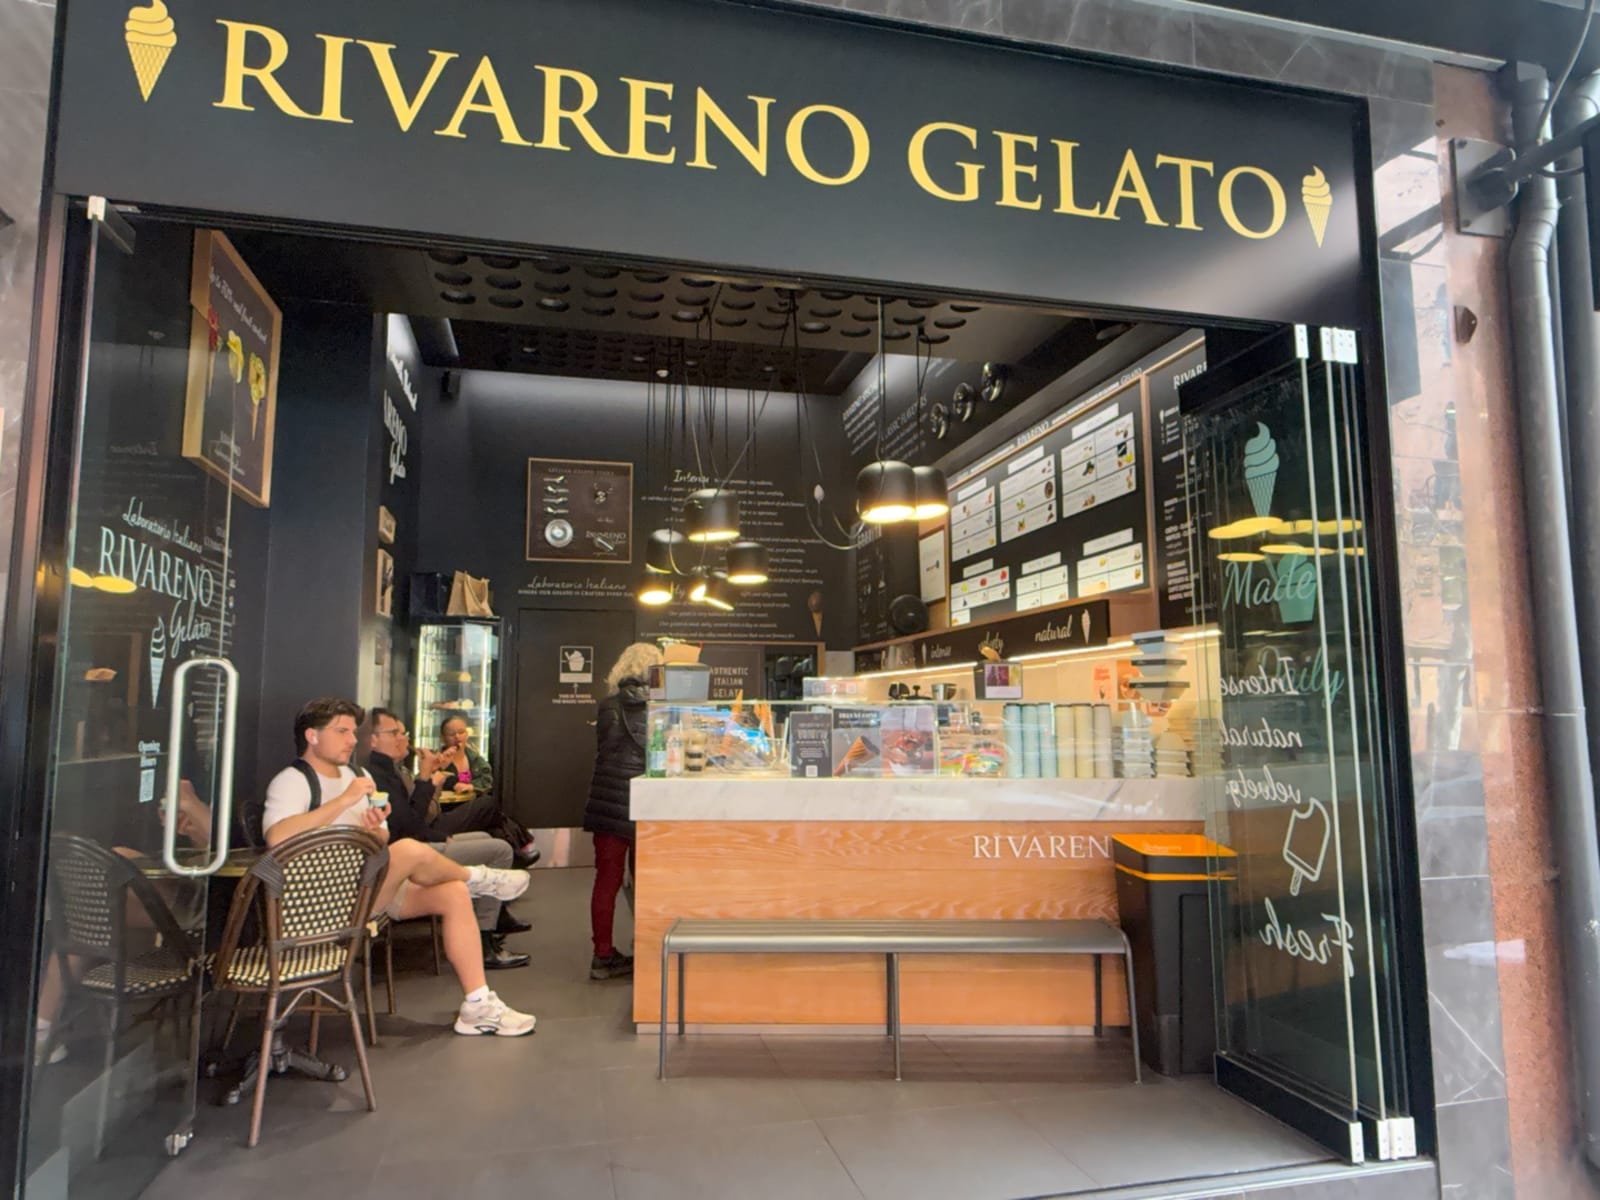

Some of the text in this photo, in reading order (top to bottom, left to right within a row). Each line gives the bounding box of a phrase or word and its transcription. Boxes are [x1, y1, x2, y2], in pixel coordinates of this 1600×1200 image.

[214, 20, 1287, 241] RIVARENO GELATO
[122, 496, 171, 539] Laboratorio
[172, 519, 202, 554] Italiano
[98, 526, 215, 608] RIVARENO
[1222, 548, 1314, 613] Made
[170, 599, 212, 659] Gelato
[1034, 613, 1073, 643] natural
[712, 688, 743, 699] GELAT
[713, 677, 744, 687] ITALIAN
[972, 834, 1112, 859] RIVAREN
